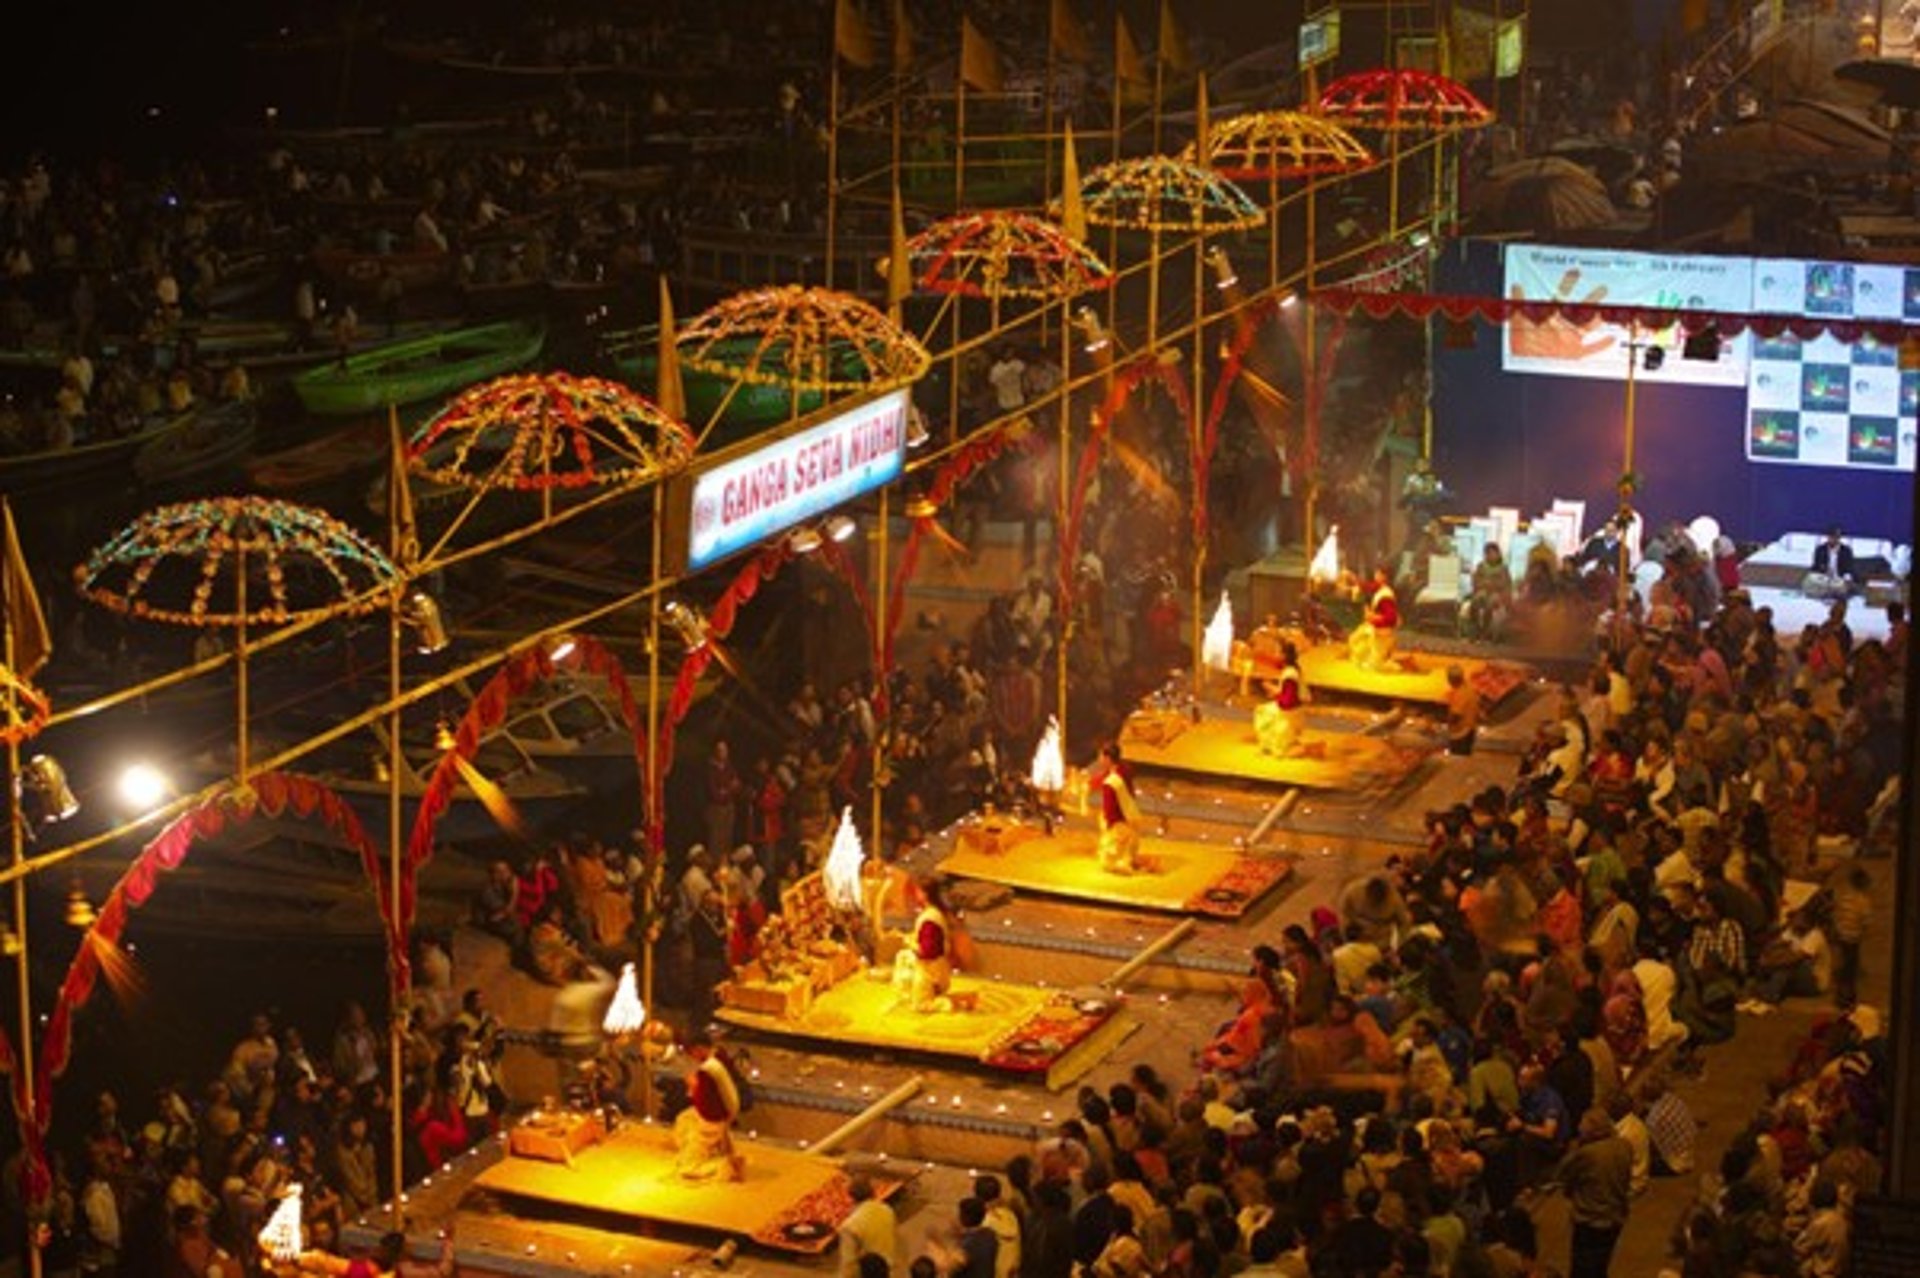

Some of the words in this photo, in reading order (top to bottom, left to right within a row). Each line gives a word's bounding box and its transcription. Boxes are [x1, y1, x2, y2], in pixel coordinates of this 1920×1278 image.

[721, 457, 788, 526] GANGA
[793, 433, 843, 494] SEVA
[848, 407, 904, 469] NIDHI
